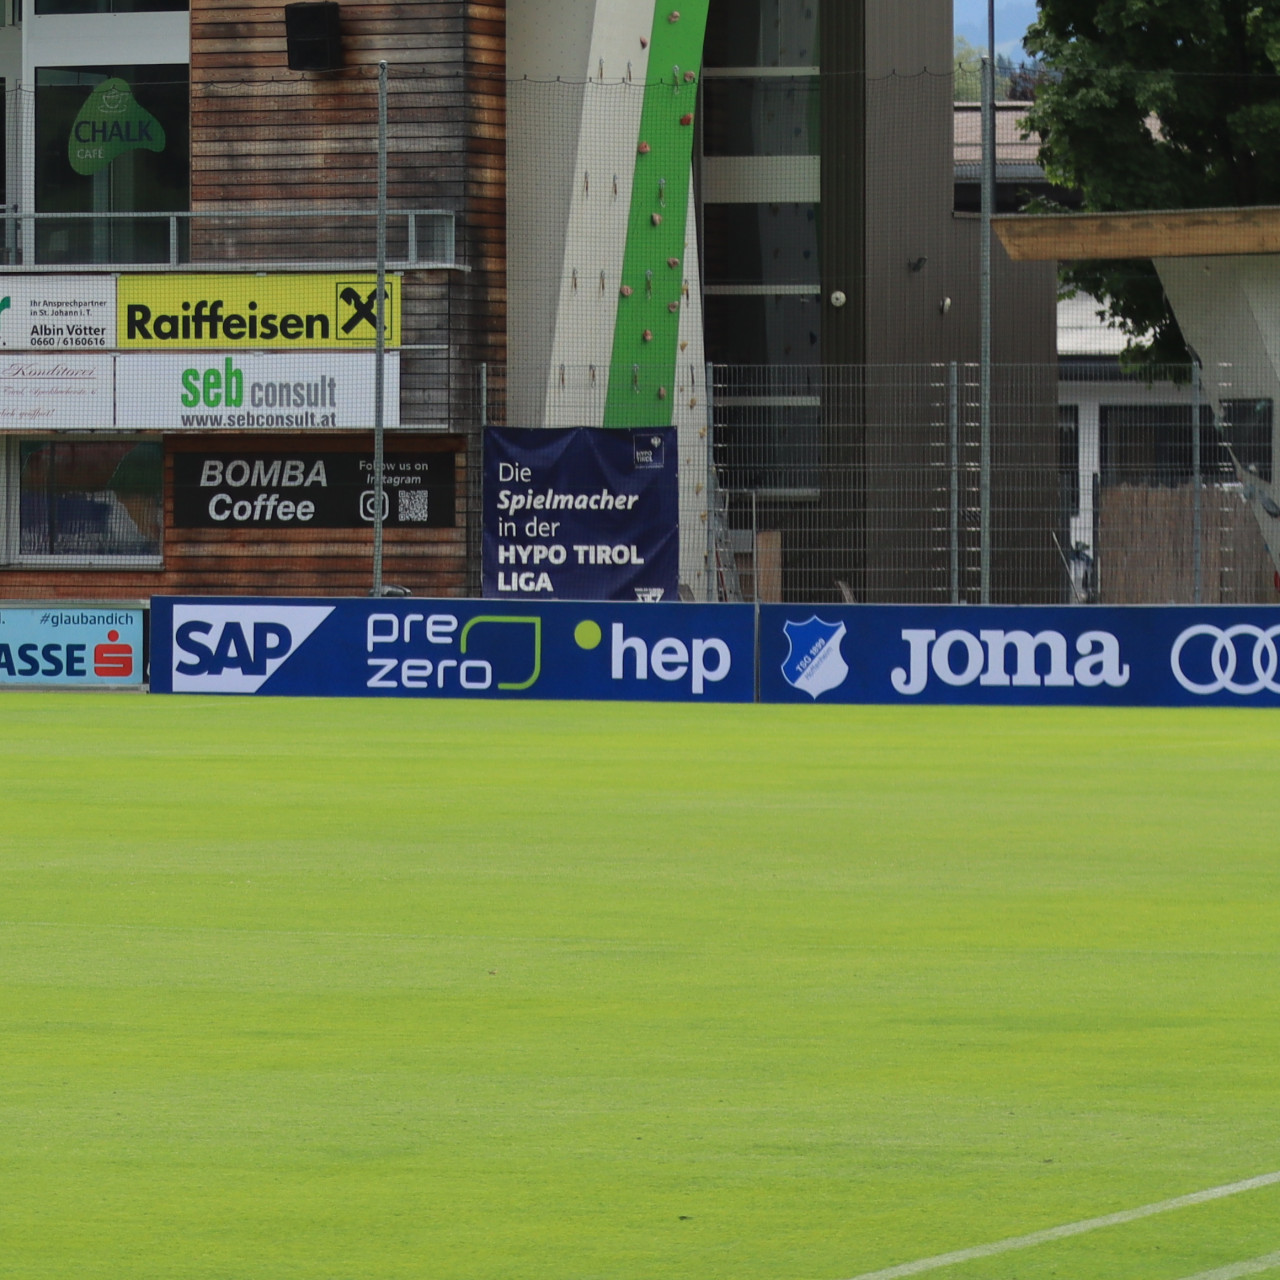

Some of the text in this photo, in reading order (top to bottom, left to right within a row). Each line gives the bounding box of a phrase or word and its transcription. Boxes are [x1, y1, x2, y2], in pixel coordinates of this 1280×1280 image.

[74, 120, 153, 143] CHALK
[30, 309, 38, 317] in
[39, 309, 50, 317] St.
[51, 309, 78, 317] Johann
[43, 300, 107, 309] Ansprechpartner
[30, 323, 107, 336] Albin Vötter
[127, 300, 330, 340] Raiffeisen
[30, 337, 55, 346] 0660
[62, 337, 106, 346] 6160616
[181, 357, 337, 408] seb consult
[181, 411, 337, 427] www.sebconsult.at
[199, 459, 328, 487] BOMBA
[359, 460, 428, 471] Foow us on
[498, 462, 532, 483] Die
[366, 473, 422, 487] Intagram
[208, 493, 316, 521] Coffee
[497, 489, 639, 515] Spielmacher
[498, 518, 561, 538] in der
[498, 543, 645, 565] HYPO TIROL
[498, 571, 554, 592] LIGA
[40, 611, 134, 627] #glaubandich
[367, 613, 458, 652] pre
[175, 620, 293, 676] SAP
[611, 622, 732, 694] hep
[366, 658, 492, 689] zero
[795, 654, 812, 673] TSG
